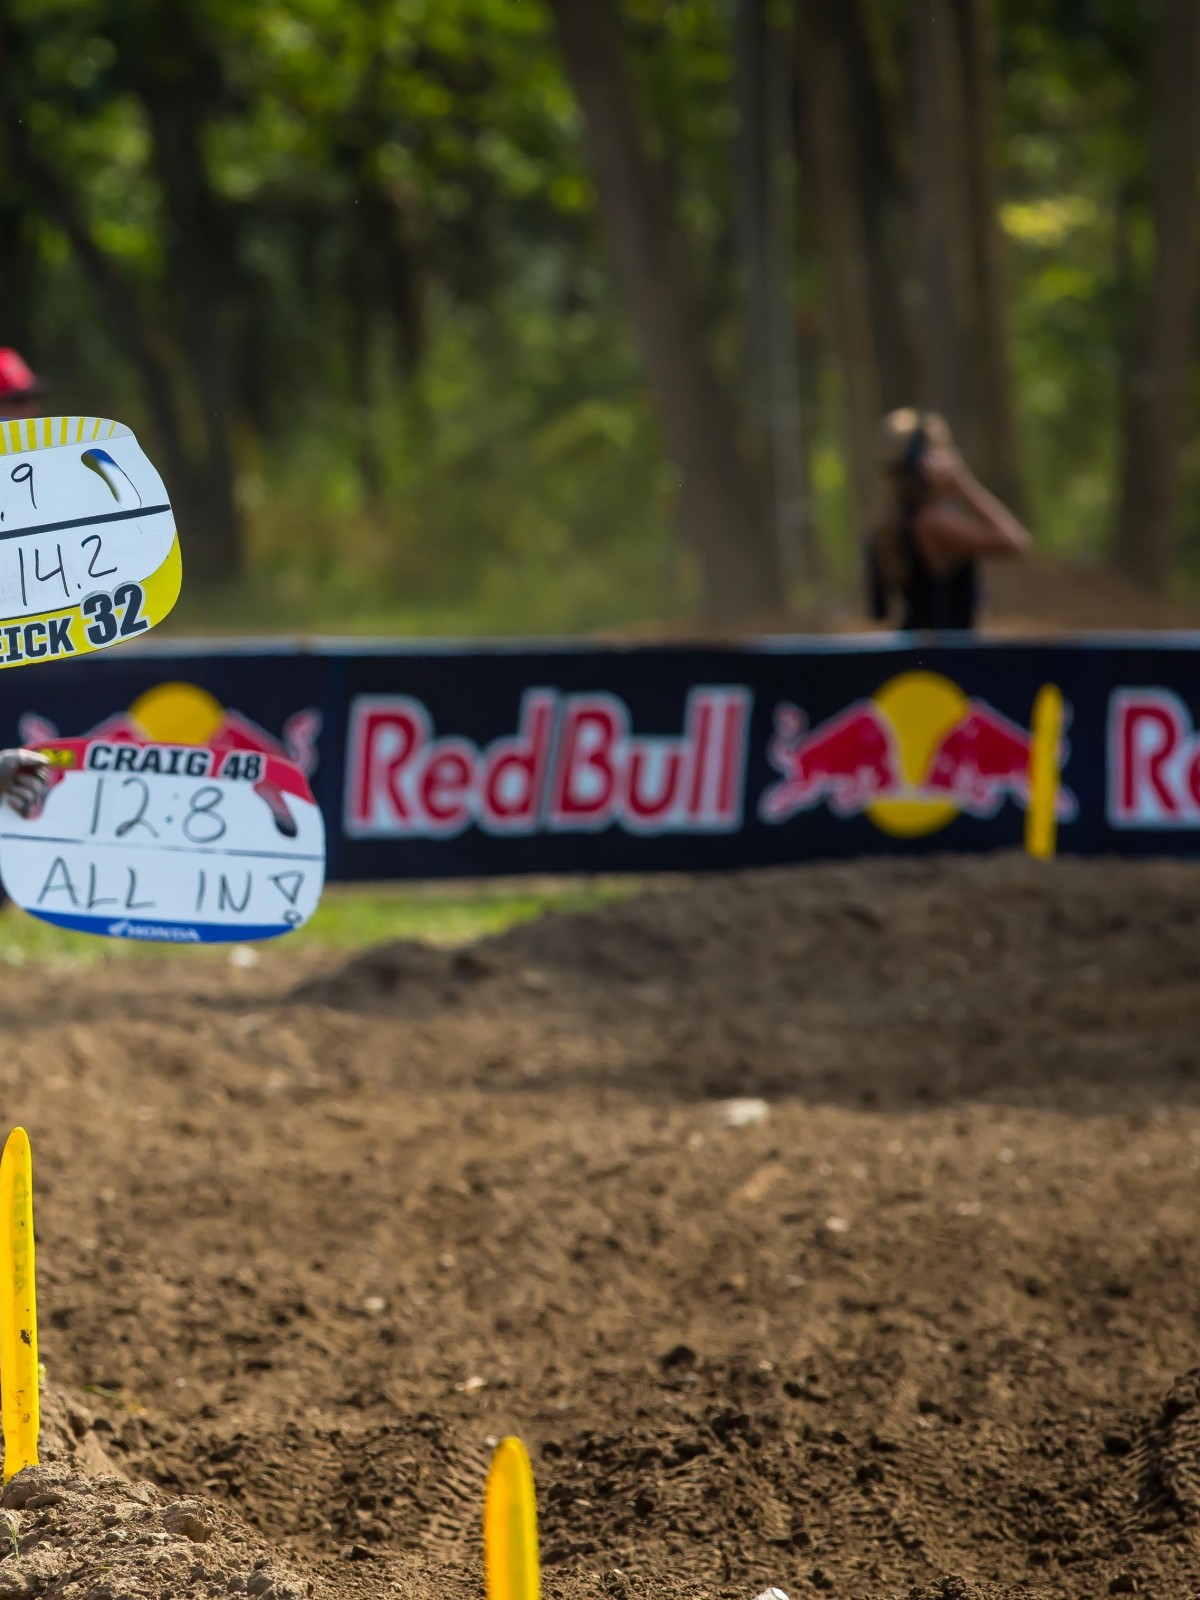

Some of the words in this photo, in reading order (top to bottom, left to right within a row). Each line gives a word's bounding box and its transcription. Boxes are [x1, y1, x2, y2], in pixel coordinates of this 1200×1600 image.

[18, 535, 117, 606] 14.2
[83, 582, 148, 645] 32
[87, 744, 211, 777] CRAIG
[220, 752, 263, 782] 48
[37, 856, 156, 910] ALL
